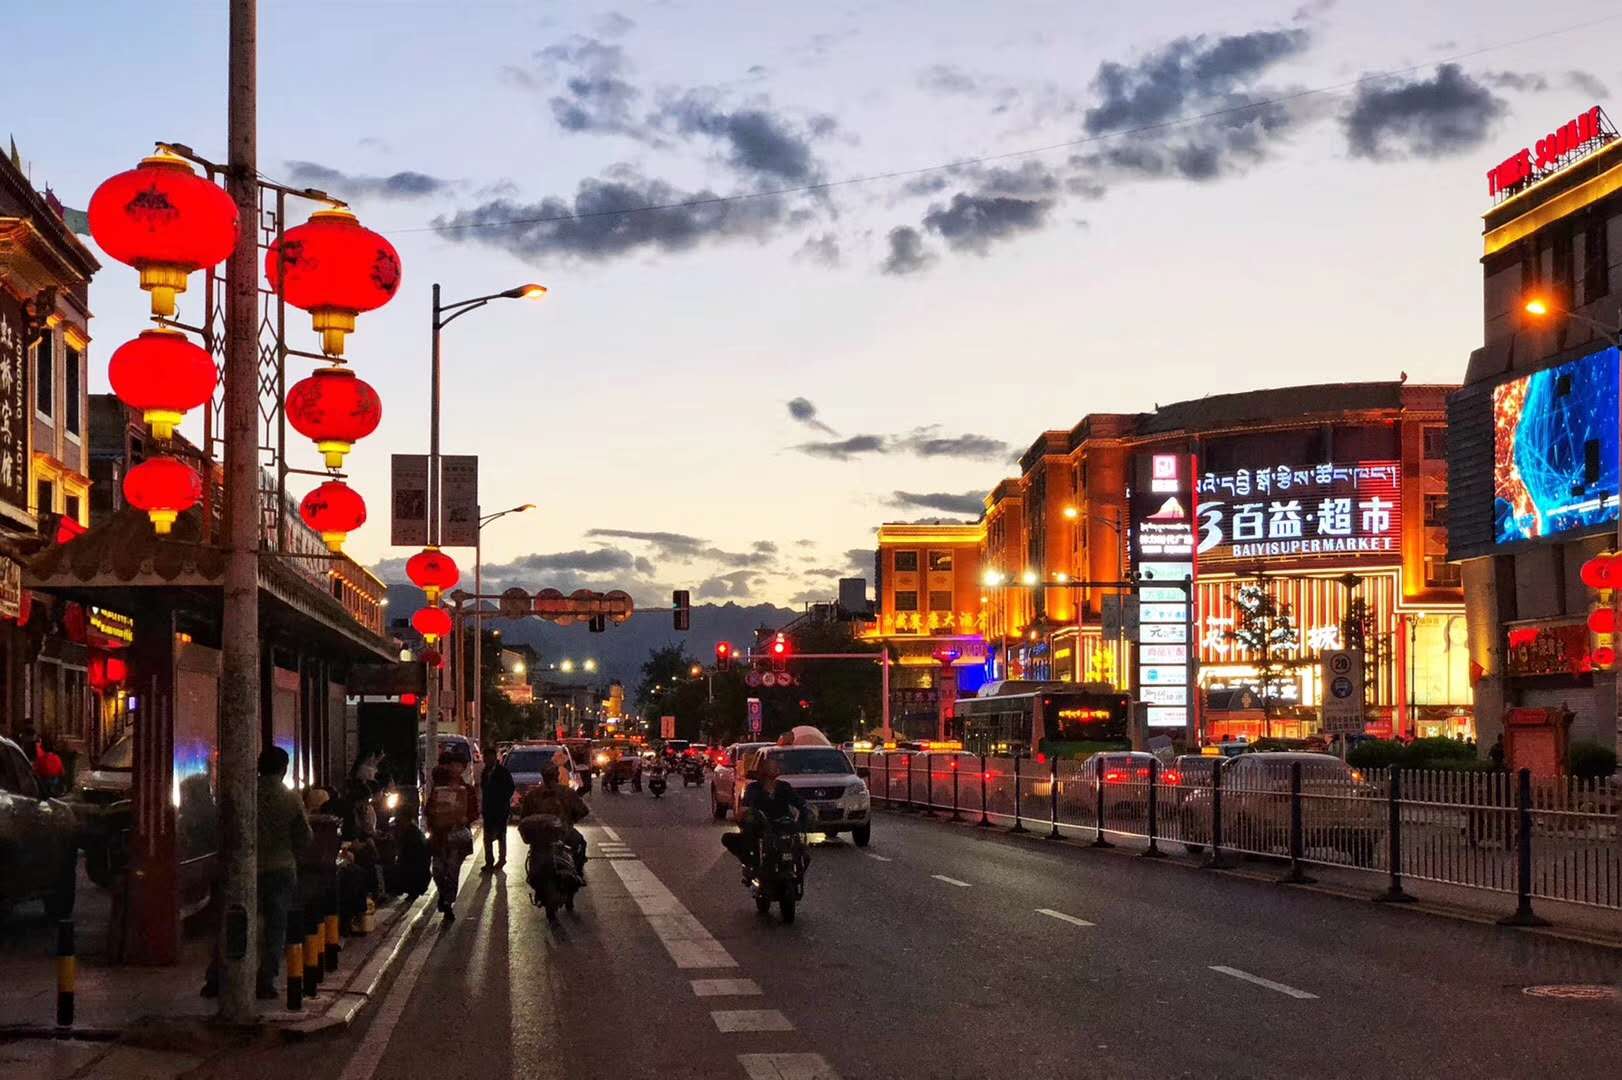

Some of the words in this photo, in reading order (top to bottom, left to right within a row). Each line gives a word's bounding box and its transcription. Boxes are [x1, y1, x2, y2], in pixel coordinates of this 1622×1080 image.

[16, 440, 24, 493] HOTEL
[1232, 496, 1394, 541] 百益·超市
